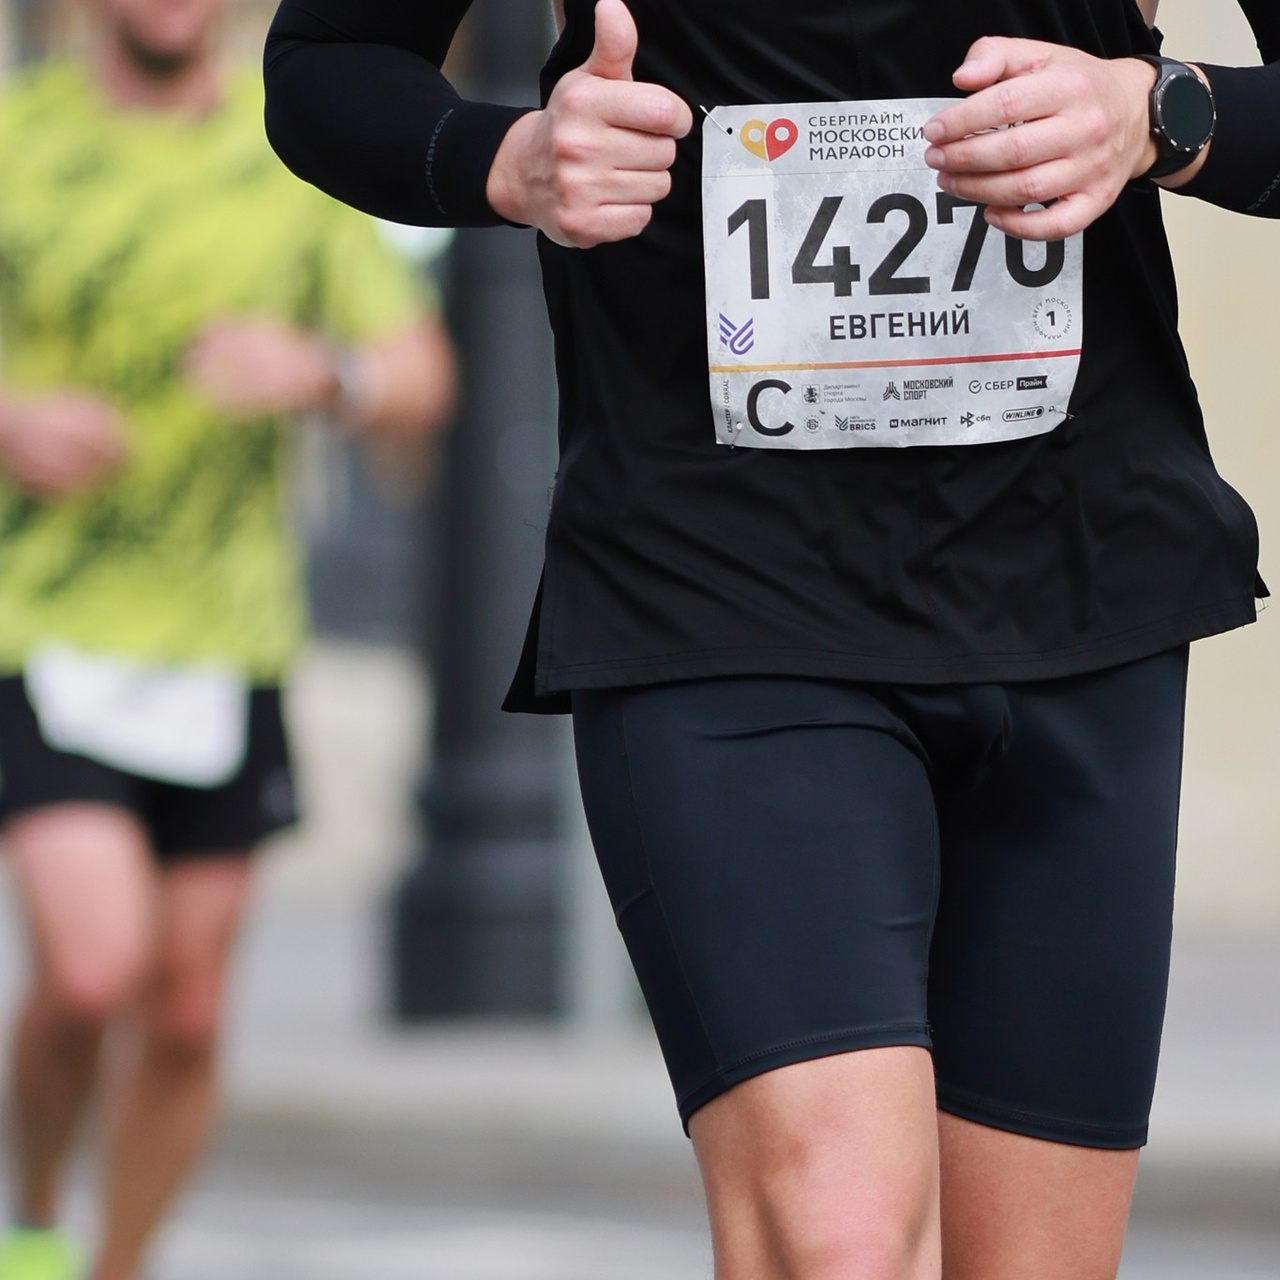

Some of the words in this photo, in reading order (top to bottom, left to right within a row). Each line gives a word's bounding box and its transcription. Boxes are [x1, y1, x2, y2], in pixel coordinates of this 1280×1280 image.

[808, 111, 904, 127] СБЕРПРАЙМ
[808, 126, 925, 144] МОСКОВСКИ
[809, 144, 905, 161] МАРАФОН
[727, 192, 1065, 300] 14270
[829, 304, 971, 341] ЕВГЕНИЙ
[1045, 310, 1056, 327] 1
[903, 376, 954, 390] МОСКОВСКИЙ
[984, 380, 1014, 391] СБЕР
[1019, 378, 1043, 388] Прайм
[903, 390, 927, 401] СПОРТ
[746, 379, 795, 437] C
[1005, 409, 1036, 420] WINLINE
[900, 417, 948, 427] магнит
[975, 414, 991, 422] сбп
[849, 423, 876, 431] BRICS
